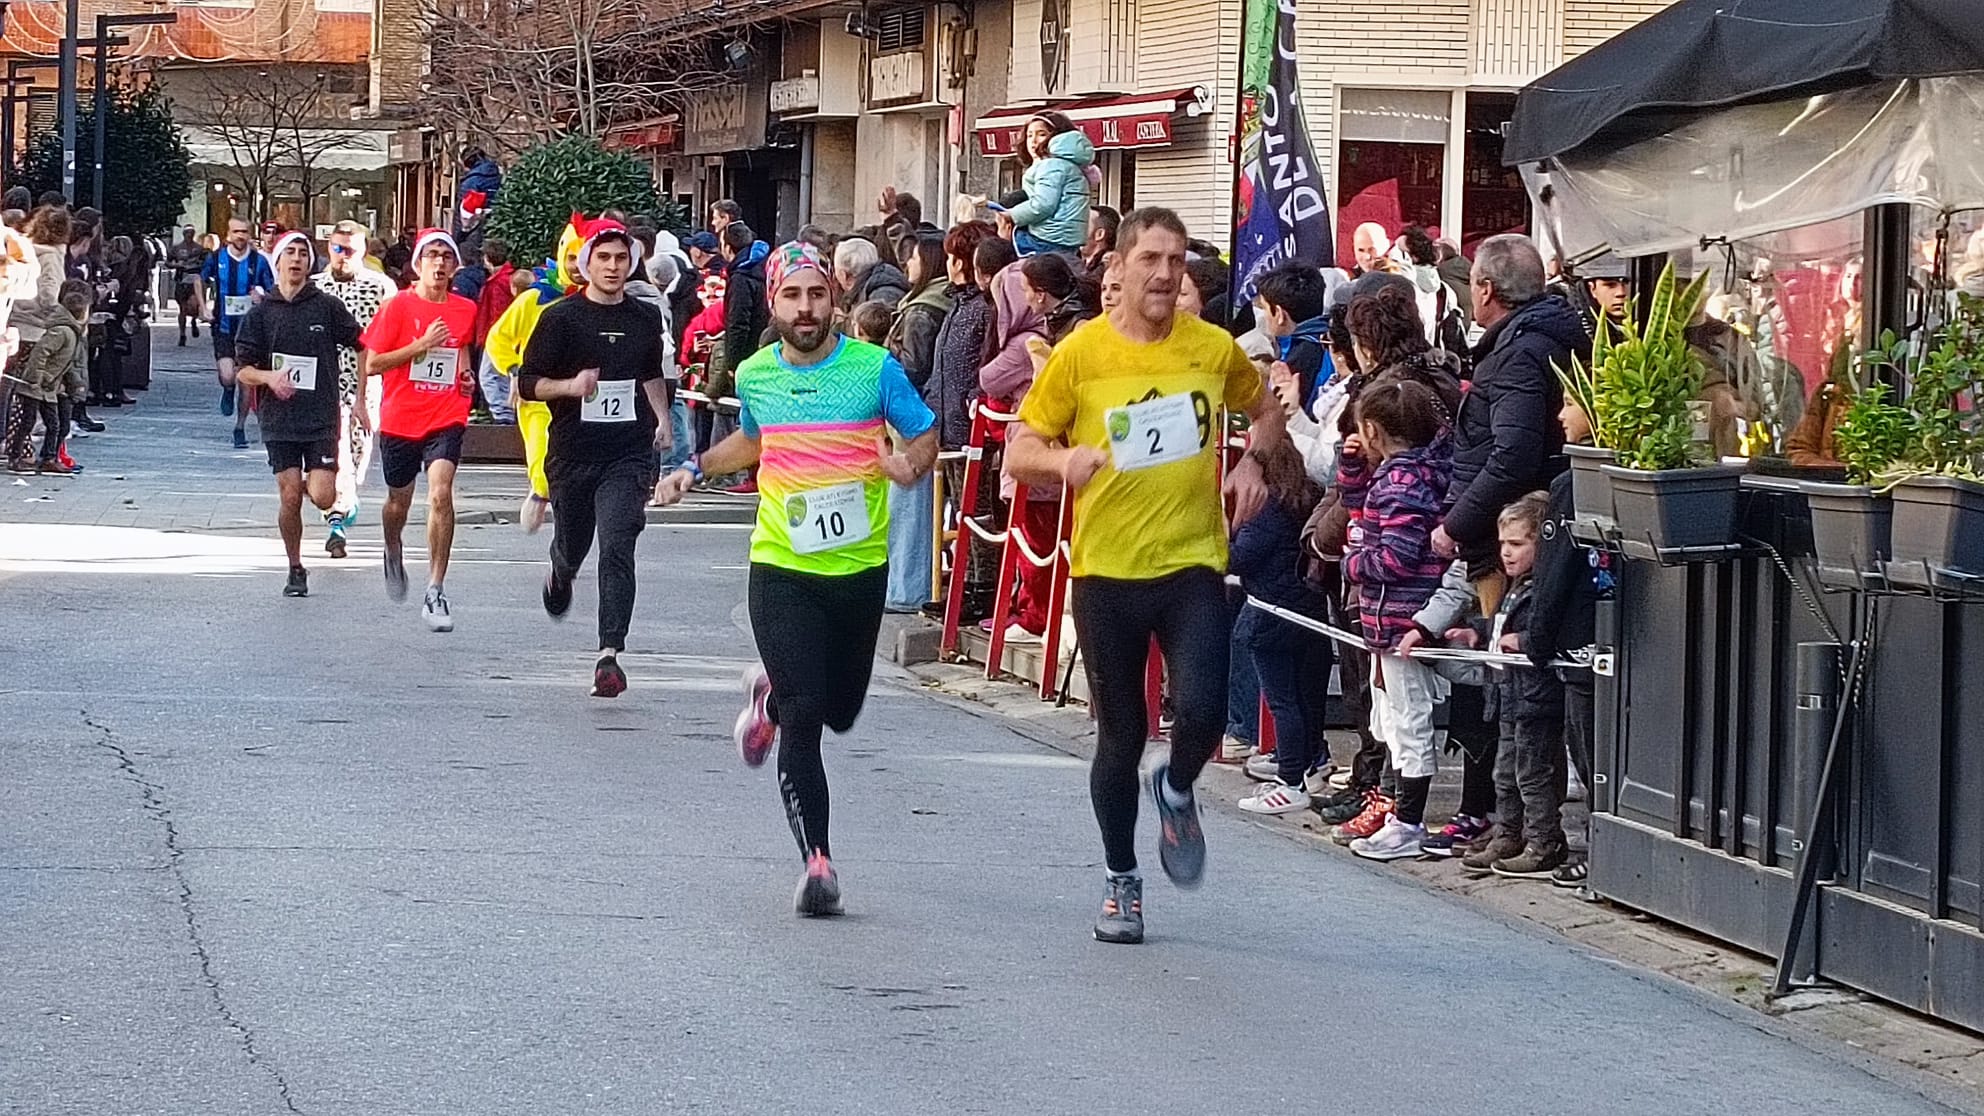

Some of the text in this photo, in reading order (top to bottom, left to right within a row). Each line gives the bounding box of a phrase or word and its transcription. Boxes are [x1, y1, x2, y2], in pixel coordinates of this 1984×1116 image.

[1262, 85, 1296, 258] SANTO
[427, 361, 444, 378] 15
[601, 398, 620, 416] 12
[1146, 427, 1164, 456] 2
[814, 511, 845, 540] 10
